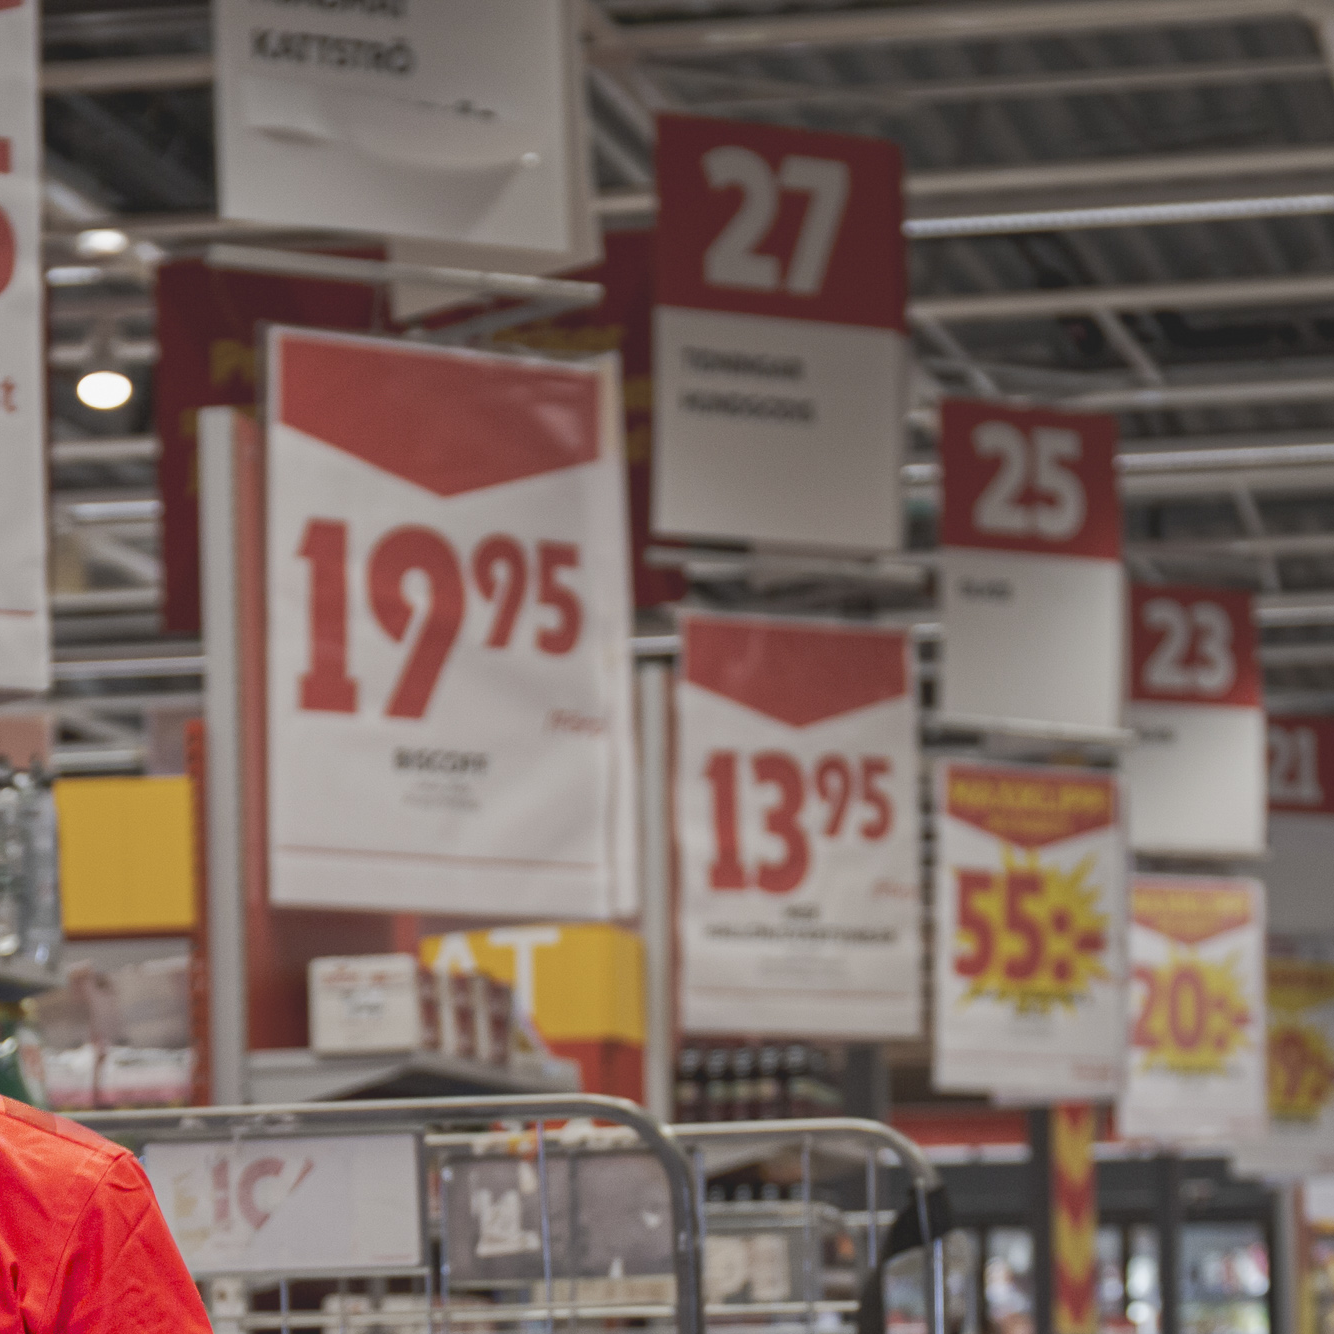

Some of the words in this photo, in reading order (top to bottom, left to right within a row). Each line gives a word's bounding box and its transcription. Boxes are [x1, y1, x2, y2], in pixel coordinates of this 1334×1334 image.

[701, 145, 850, 295] 27
[970, 421, 1088, 541] 25
[1139, 600, 1239, 695] 23
[1268, 723, 1323, 801] 21
